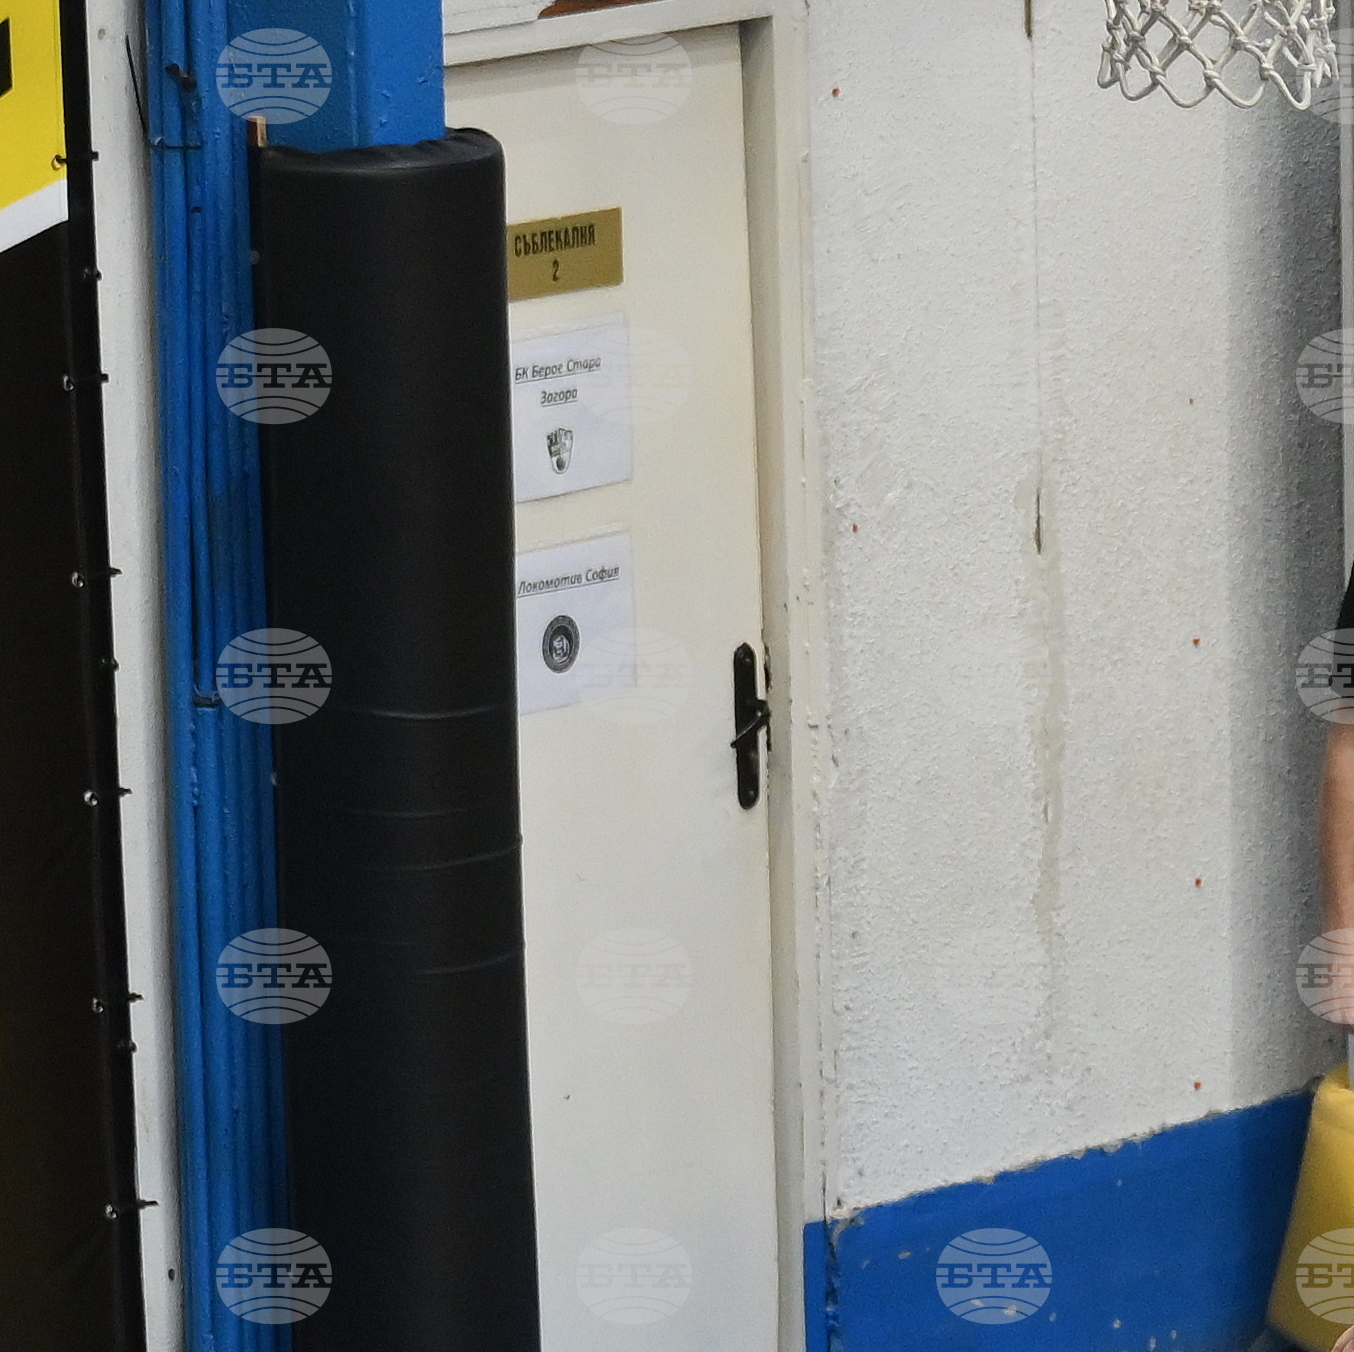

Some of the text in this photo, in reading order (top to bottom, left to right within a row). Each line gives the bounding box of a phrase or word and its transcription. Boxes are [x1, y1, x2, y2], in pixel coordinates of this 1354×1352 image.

[552, 259, 559, 282] 2
[515, 367, 529, 381] БК
[518, 566, 620, 595] Локомотив София
